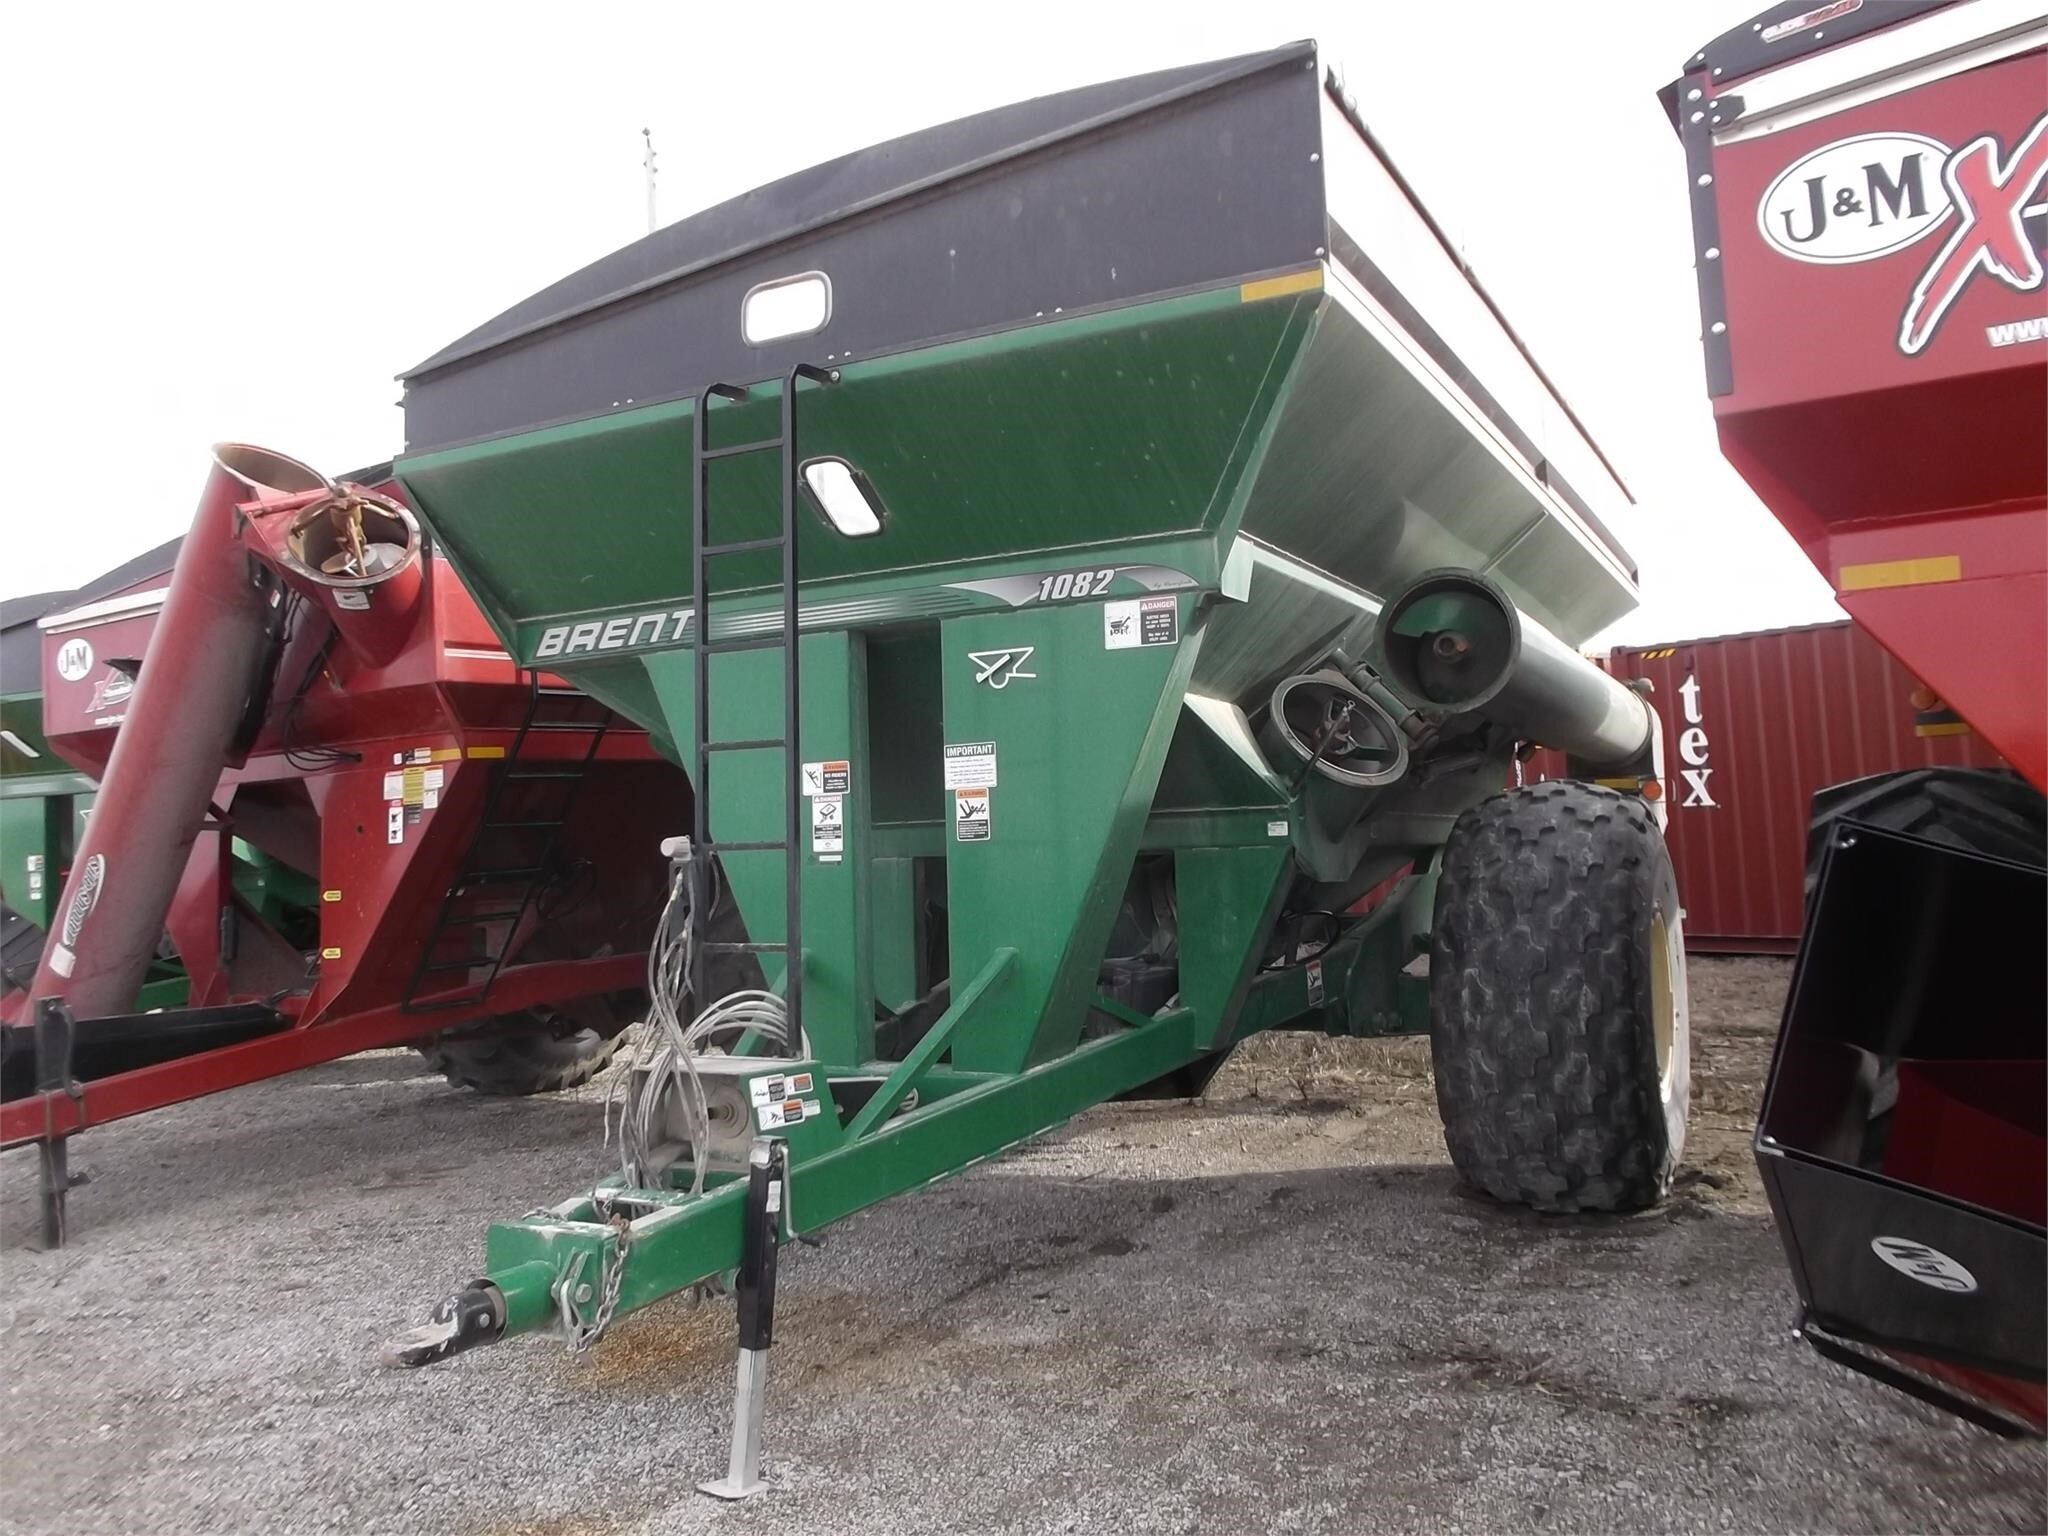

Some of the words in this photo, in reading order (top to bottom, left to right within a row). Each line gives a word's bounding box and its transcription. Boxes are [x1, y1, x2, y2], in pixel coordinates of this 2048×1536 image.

[1780, 152, 1930, 243] J&M
[1985, 316, 2048, 347] ww
[1040, 569, 1115, 601] 1082
[1148, 600, 1174, 609] DANGER
[536, 609, 696, 657] BRENT
[946, 744, 993, 757] IMPORTANT
[1678, 674, 1716, 807] tex
